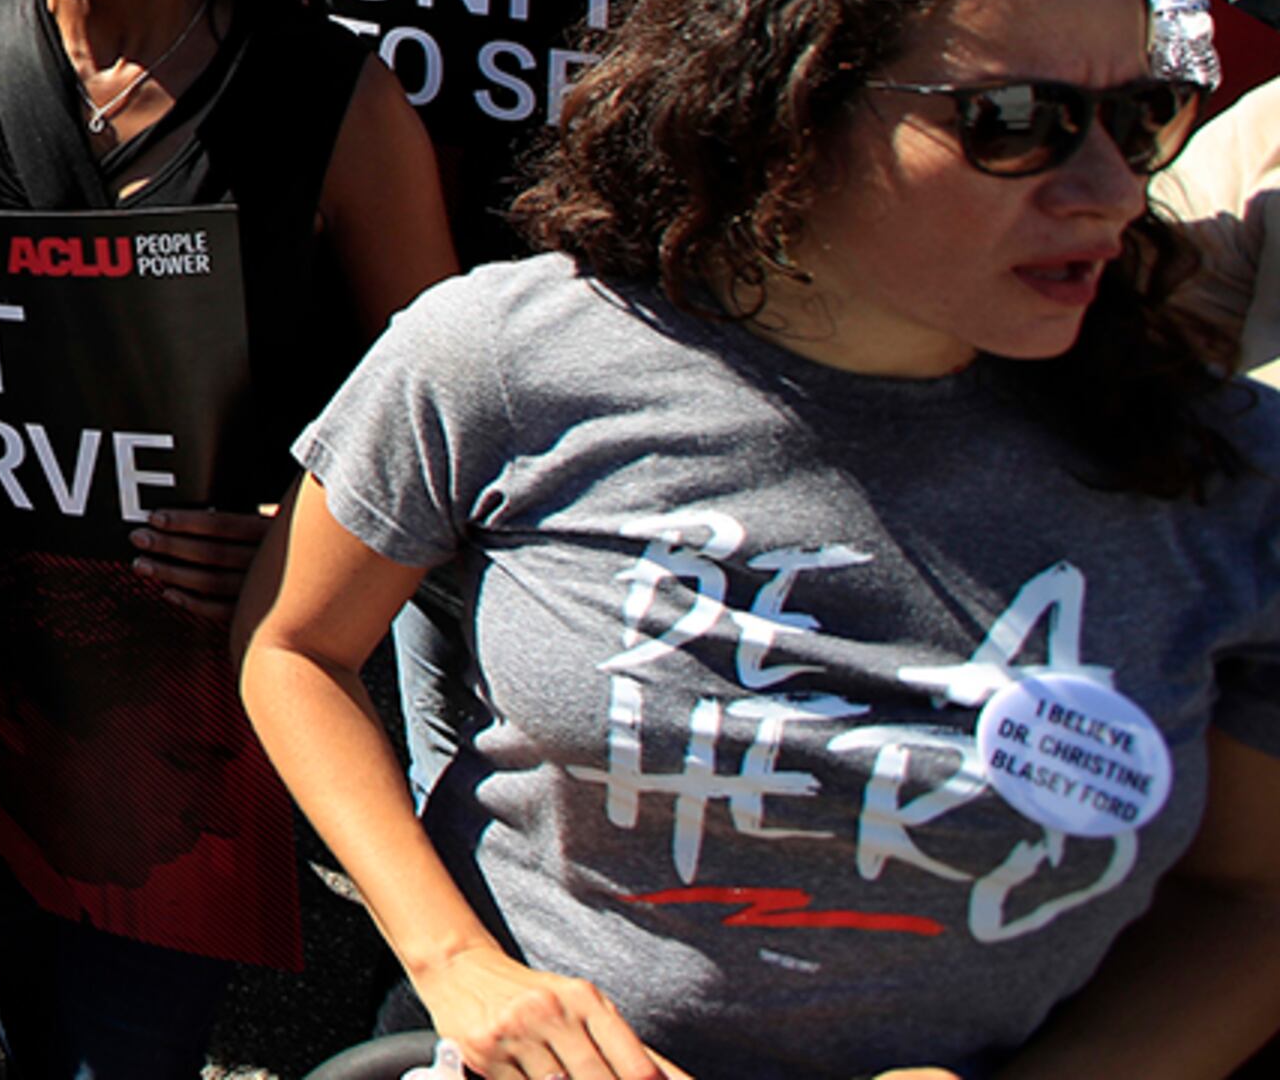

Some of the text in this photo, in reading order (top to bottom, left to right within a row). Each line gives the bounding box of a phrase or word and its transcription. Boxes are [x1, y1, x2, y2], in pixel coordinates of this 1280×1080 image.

[328, 14, 445, 107] O
[7, 231, 208, 277] ACLU PEOPLE
[137, 254, 211, 277] POWER
[597, 509, 1116, 708] BE A
[998, 717, 1153, 796] DR. CHRISTINE
[1035, 700, 1136, 754] I BELIEVE
[565, 692, 1140, 943] HERO
[991, 749, 1139, 822] BLASEY FORD
